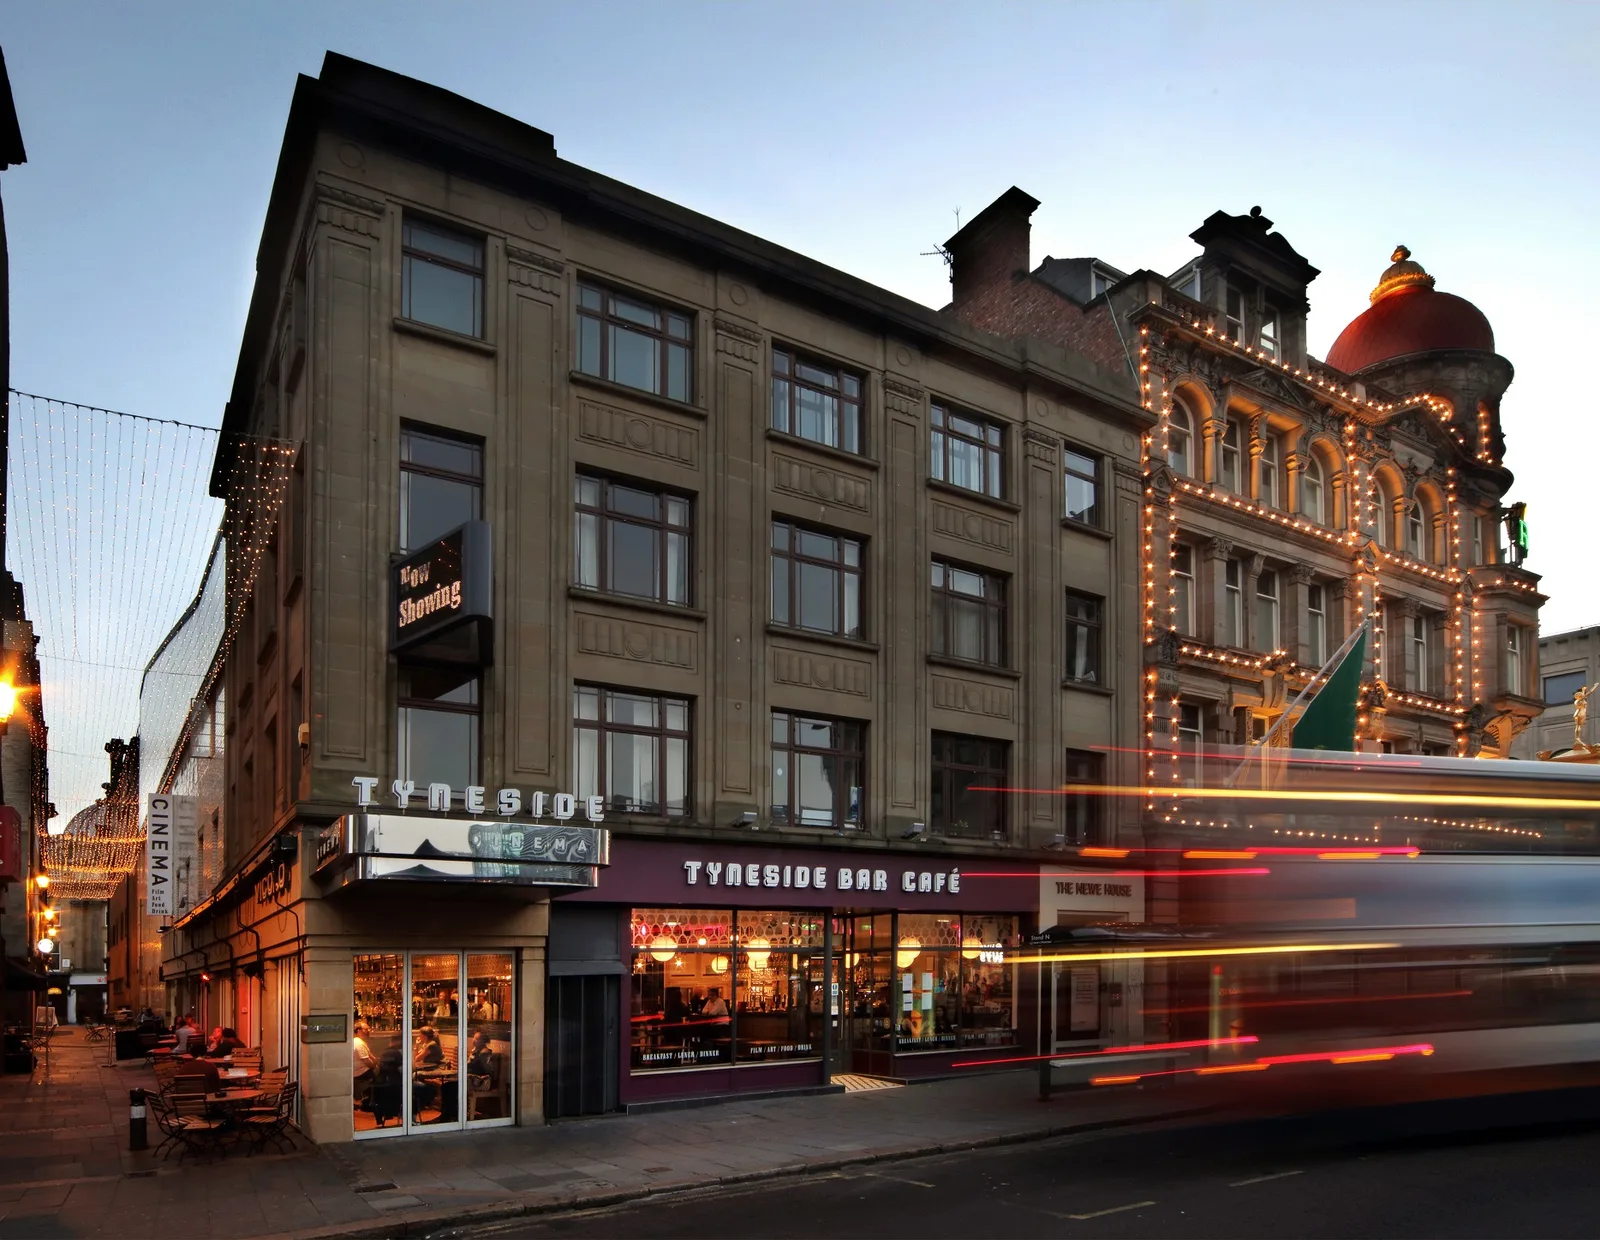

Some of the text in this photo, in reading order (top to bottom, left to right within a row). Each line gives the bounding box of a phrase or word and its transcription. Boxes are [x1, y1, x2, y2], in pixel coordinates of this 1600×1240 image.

[399, 580, 461, 627] Showing
[351, 776, 605, 822] TYNESIDE
[151, 799, 169, 886] CINEMA
[684, 861, 960, 893] TYNESIDE BAR CAFÉ
[1056, 881, 1132, 897] THE NEWE HOUSE
[642, 1051, 673, 1061] BREAKFAST
